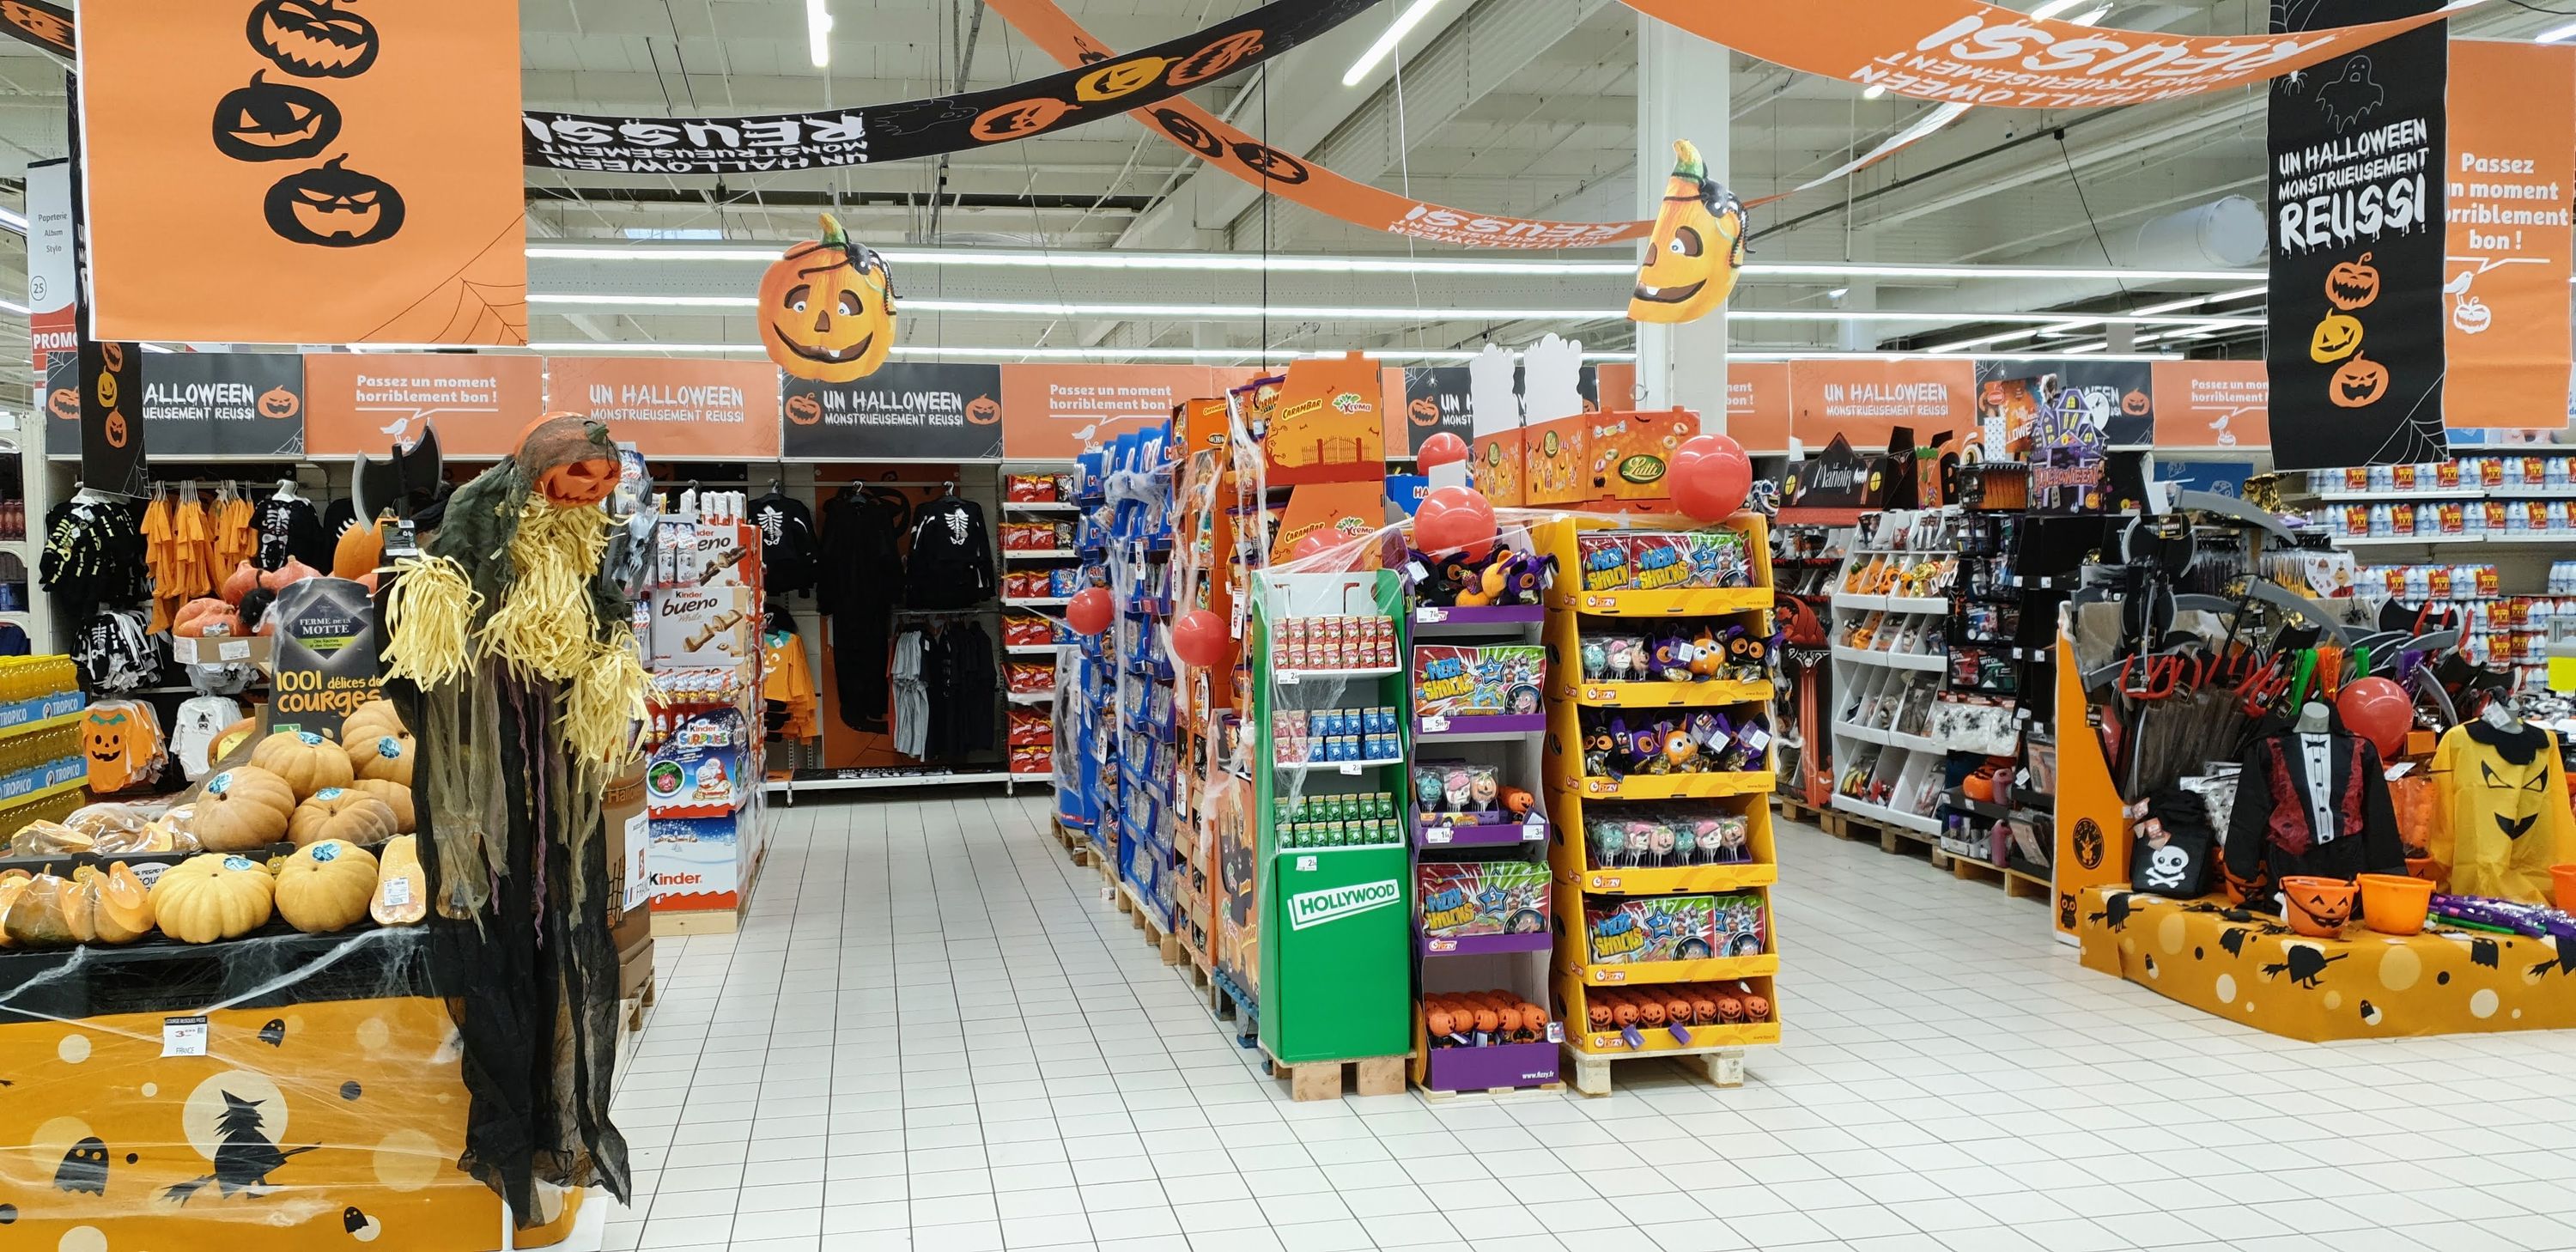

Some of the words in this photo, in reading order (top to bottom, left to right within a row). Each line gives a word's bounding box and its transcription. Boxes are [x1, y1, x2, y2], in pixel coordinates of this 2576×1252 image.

[1917, 10, 2337, 77] REUSSI
[1849, 64, 2144, 109] HALLOWEEN
[523, 112, 866, 148] REUSSI
[538, 141, 869, 160] MONSTRUEUSEMENT
[2279, 152, 2301, 177] UN
[2305, 118, 2428, 174] HALLOWEEN
[548, 156, 810, 173] HALLOWEEN
[821, 153, 868, 166] UN
[2461, 153, 2535, 173] Passez
[2278, 148, 2430, 203] MONSTRUEUSEMENT
[2469, 181, 2559, 200] moment
[1405, 203, 1631, 238] REUSSI
[2279, 173, 2428, 258] REUSSI
[46, 245, 63, 253] Stylo
[2470, 229, 2512, 250] bon
[33, 283, 45, 295] 25
[357, 375, 408, 387] Passez
[412, 378, 430, 387] un
[434, 376, 496, 388] moment
[1049, 385, 1095, 396] Passez
[1098, 386, 1115, 396] un
[1118, 386, 1171, 397] moment
[2191, 379, 2228, 389] Passez
[143, 383, 254, 409] ALLOWEEN
[356, 390, 457, 402] horriblement
[461, 391, 489, 402] bon
[590, 385, 613, 406] UN
[621, 385, 744, 408] HALLOWEEN
[823, 391, 848, 410] UN
[854, 391, 963, 413] HALLOWEEN
[1441, 393, 1461, 412] UN
[1825, 385, 1844, 401] UN
[1850, 384, 1948, 404] HALLOWEEN
[2191, 391, 2263, 402] horriblement
[215, 405, 255, 421] REUSSI
[1049, 398, 1139, 410] horriblement
[1141, 398, 1165, 410] bon
[1283, 399, 1322, 419] CARAMBAR
[1343, 402, 1371, 414] Krema
[1826, 405, 1915, 416] MONSTRUEUSEMENT
[1917, 405, 1949, 417] REUSSI
[590, 410, 702, 422] MONSTRUEUSEMENT
[705, 410, 744, 422] REUSSI
[824, 413, 925, 427] MONSTRUEUSEMENT
[928, 414, 964, 428] REUSSI
[1622, 458, 1660, 477] Lutti
[2033, 464, 2100, 495] HALLOWEEN
[697, 537, 731, 551] eno
[662, 597, 718, 617] bueno
[302, 624, 350, 635] MOTTE
[276, 670, 322, 691] 1001
[327, 677, 366, 690] délices
[368, 674, 382, 688] de
[52, 698, 79, 715] TROPICO
[3, 778, 33, 799] TROPICO
[55, 763, 81, 781] TROPICO
[1300, 884, 1394, 915] HOLLYWOOD
